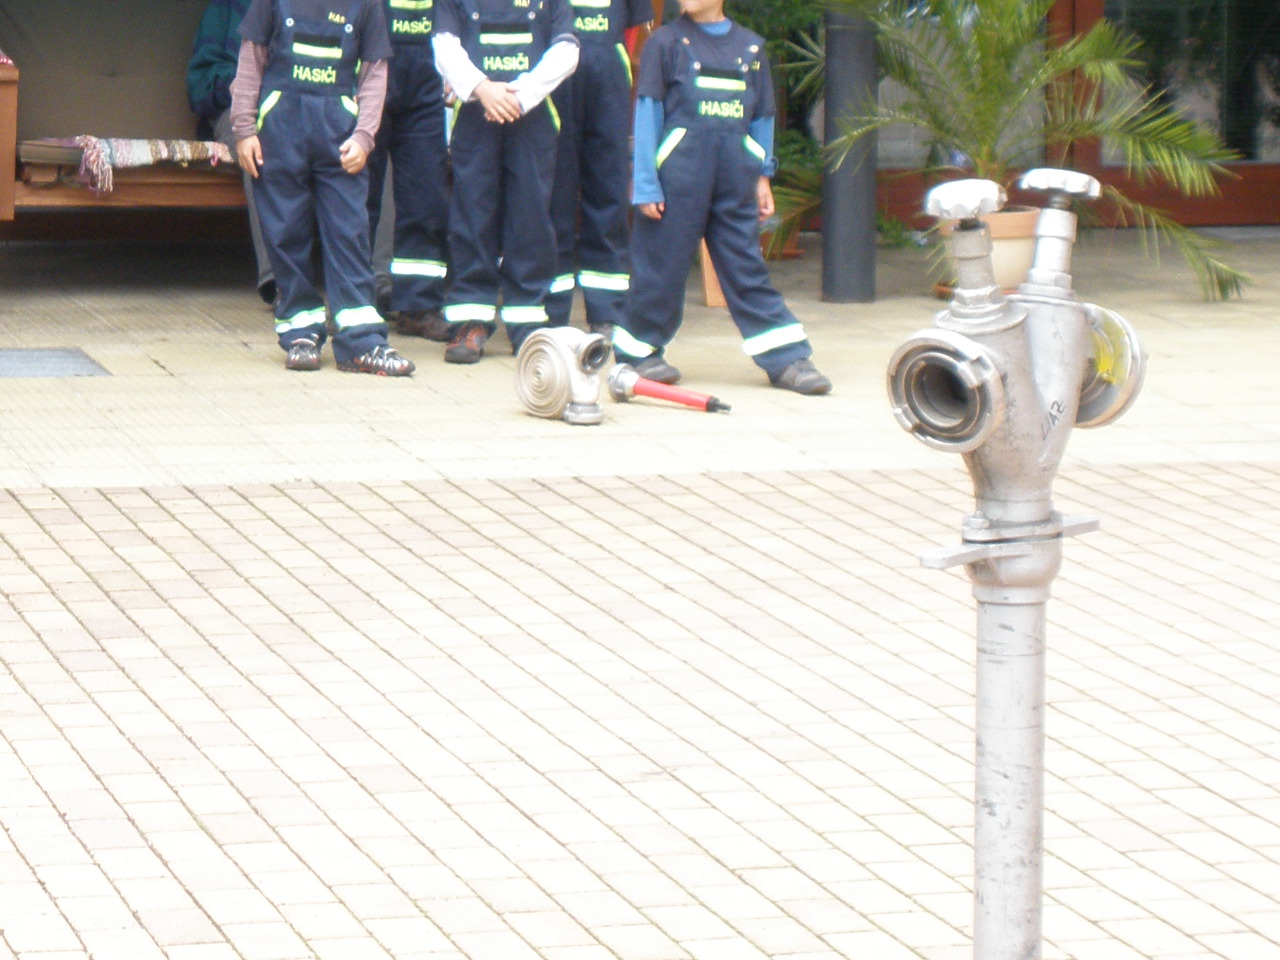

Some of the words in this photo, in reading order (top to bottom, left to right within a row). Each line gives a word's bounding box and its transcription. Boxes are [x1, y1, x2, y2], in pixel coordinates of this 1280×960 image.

[574, 13, 609, 32] ASIČI
[483, 52, 530, 71] HASIČI
[293, 64, 337, 84] HASIČI
[700, 99, 744, 119] HASIČI
